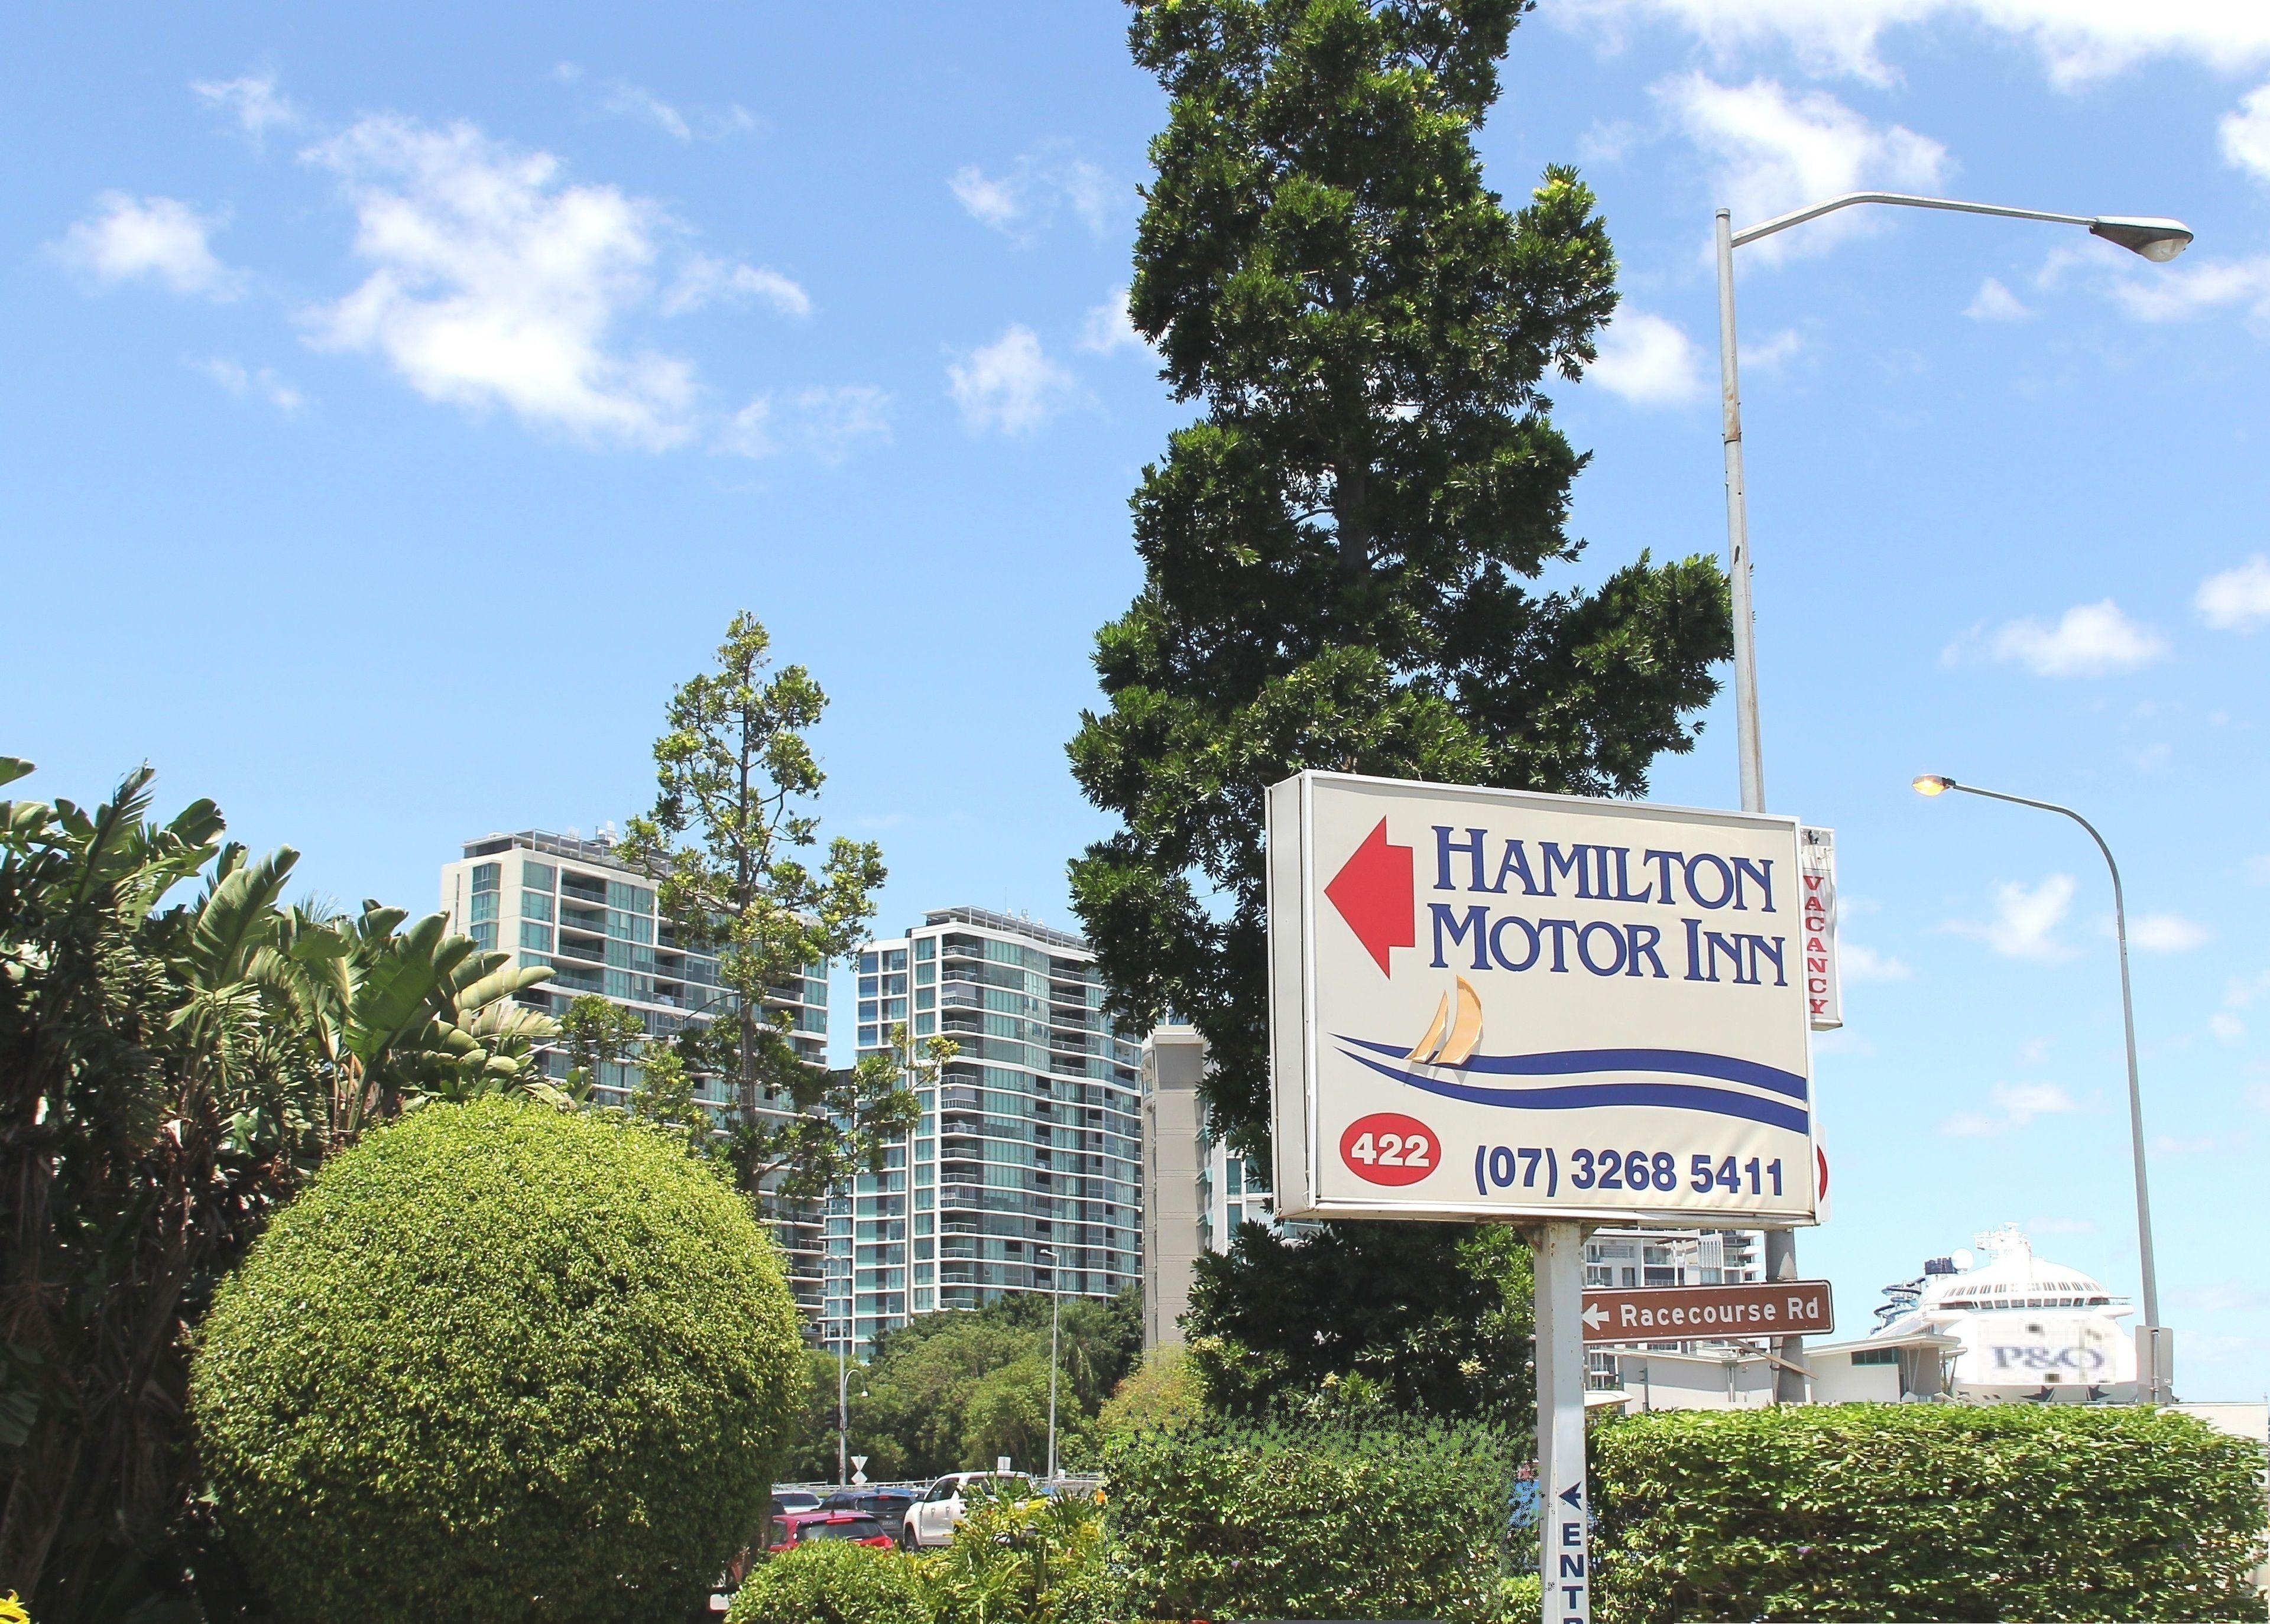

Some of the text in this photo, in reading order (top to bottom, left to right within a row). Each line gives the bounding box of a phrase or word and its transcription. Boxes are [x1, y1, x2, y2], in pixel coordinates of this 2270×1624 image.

[1431, 825, 1776, 914] HAMILTON
[1428, 902, 1788, 987] MOTOR INN
[1803, 875, 1828, 1014] VACANCY
[1351, 1132, 1429, 1167] 422
[1475, 1145, 1783, 1197] (07) 3268 5411
[1620, 1297, 1819, 1327] Racecourse Rd
[1560, 1522, 1584, 1624] ENT
